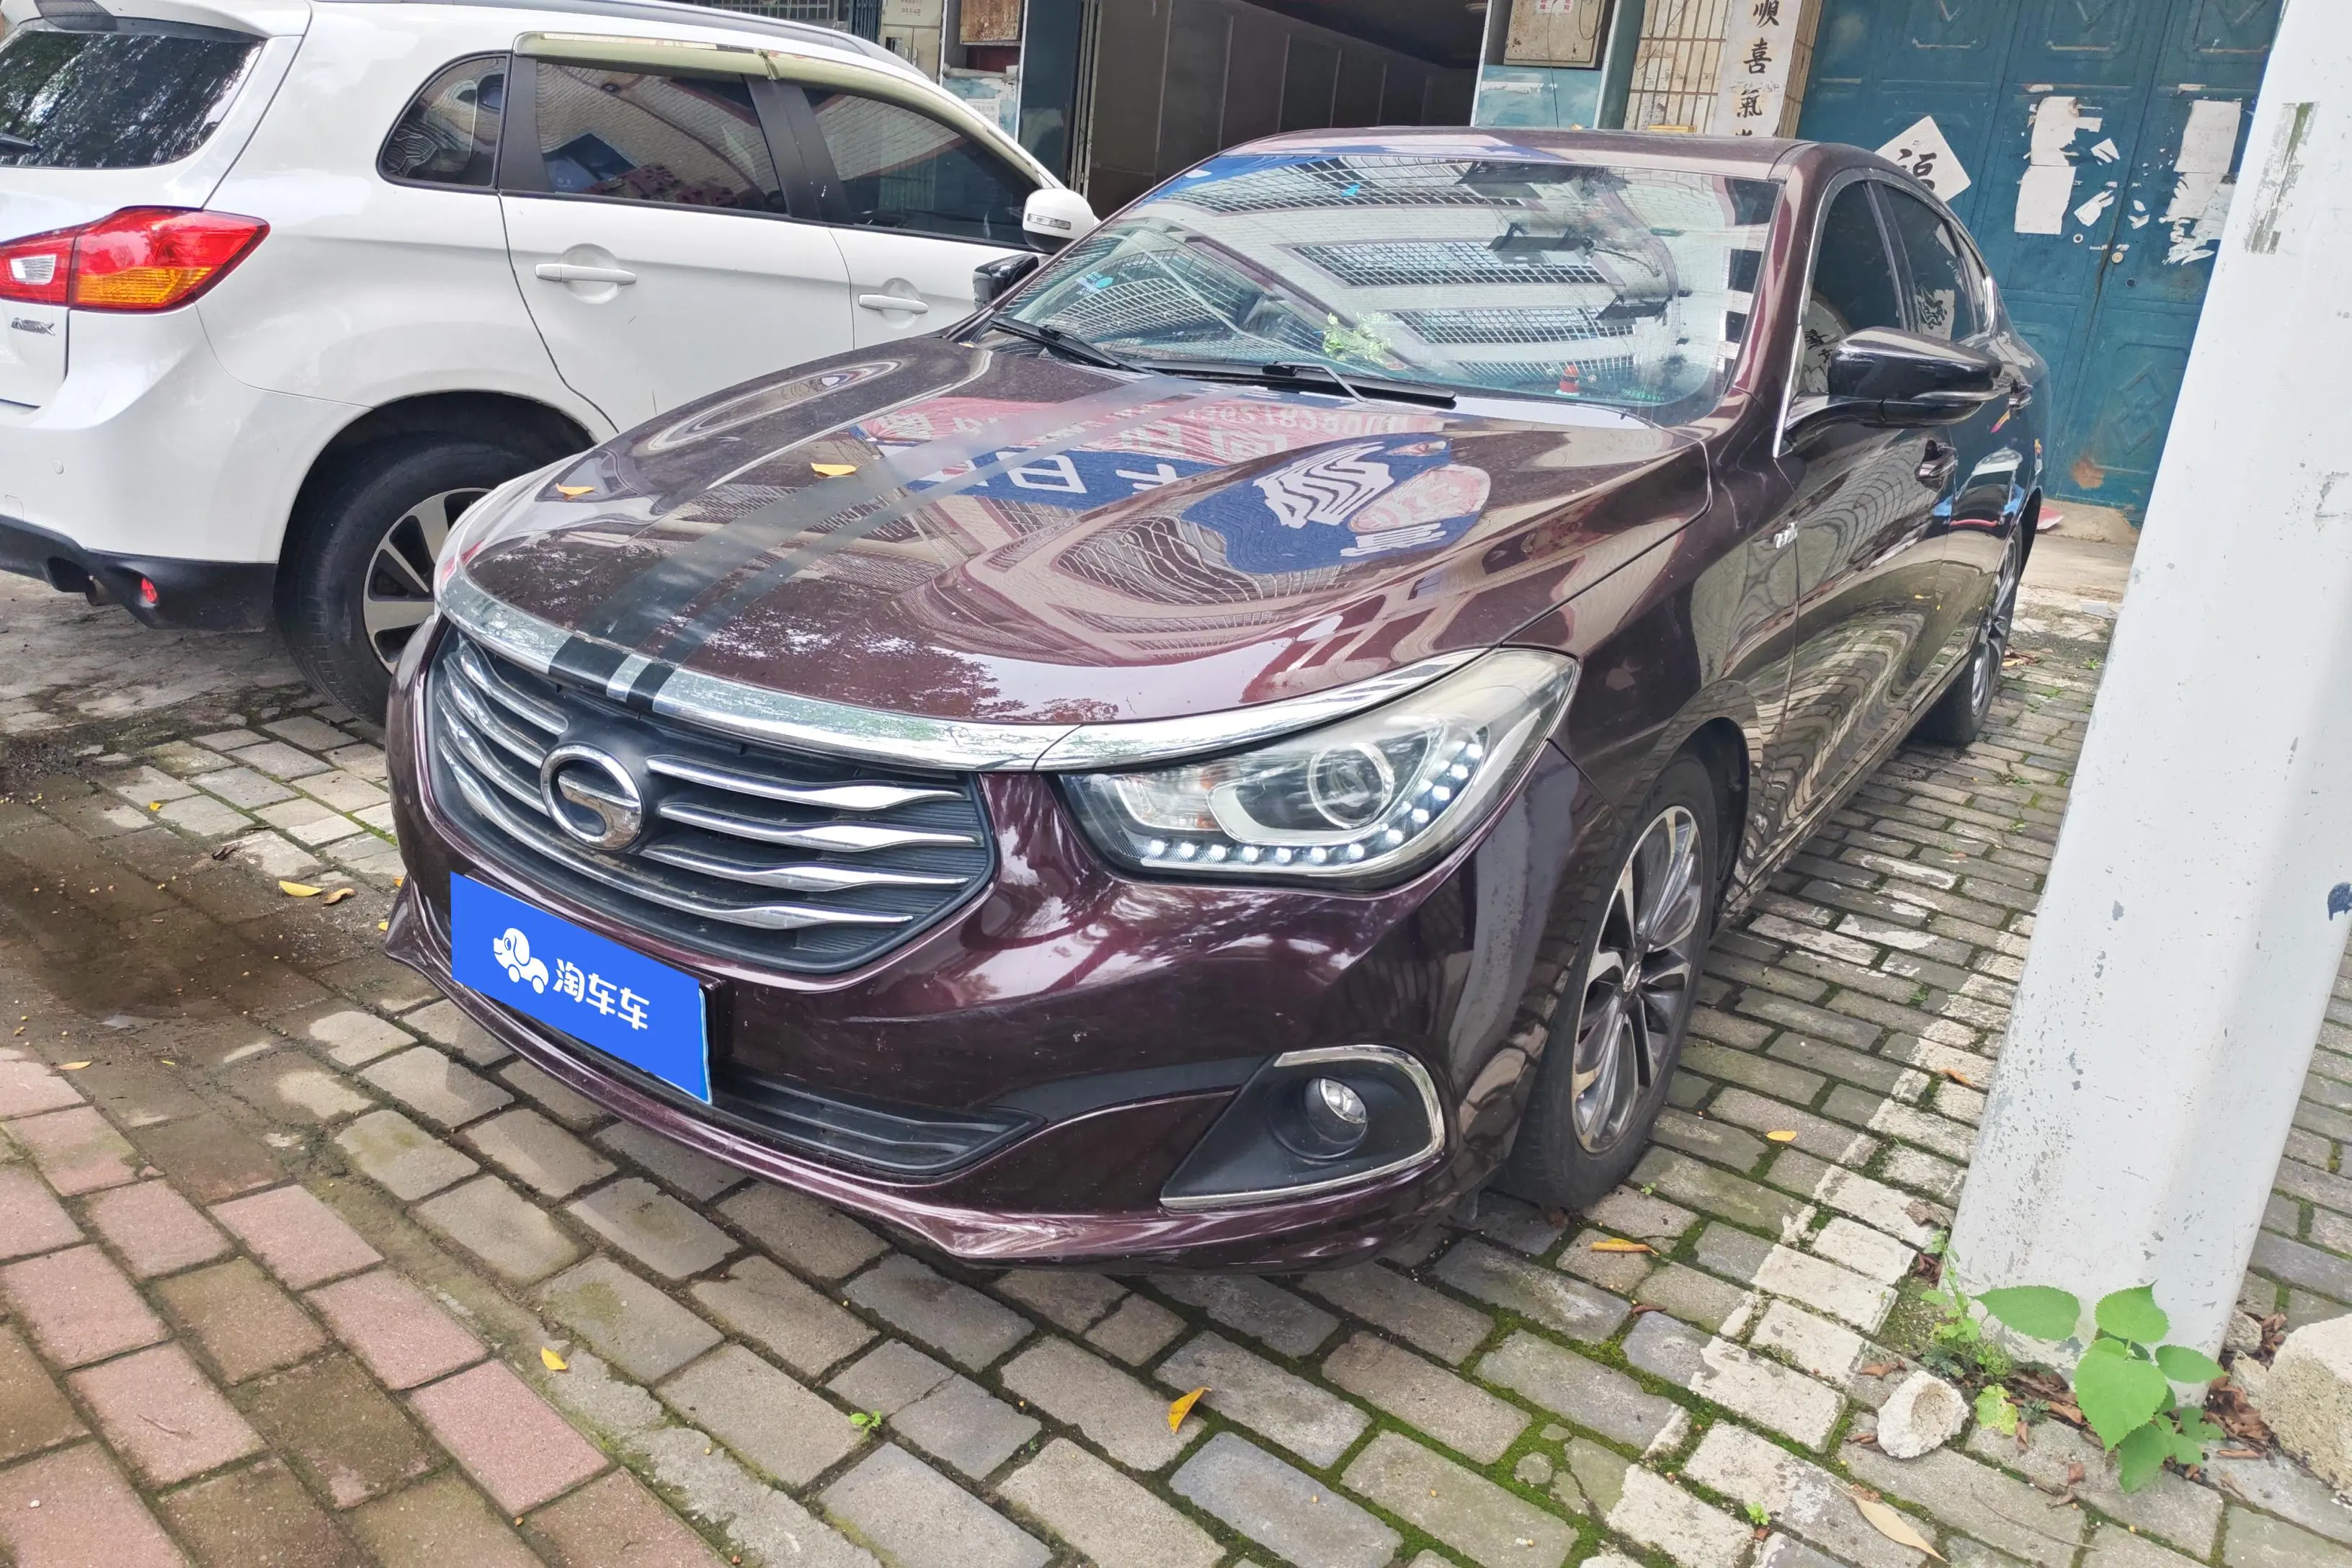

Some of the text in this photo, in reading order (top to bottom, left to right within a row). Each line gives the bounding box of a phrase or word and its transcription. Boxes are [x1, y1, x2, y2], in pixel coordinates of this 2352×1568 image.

[1735, 0, 1780, 136] 順喜氣
[11, 317, 55, 336] ASX
